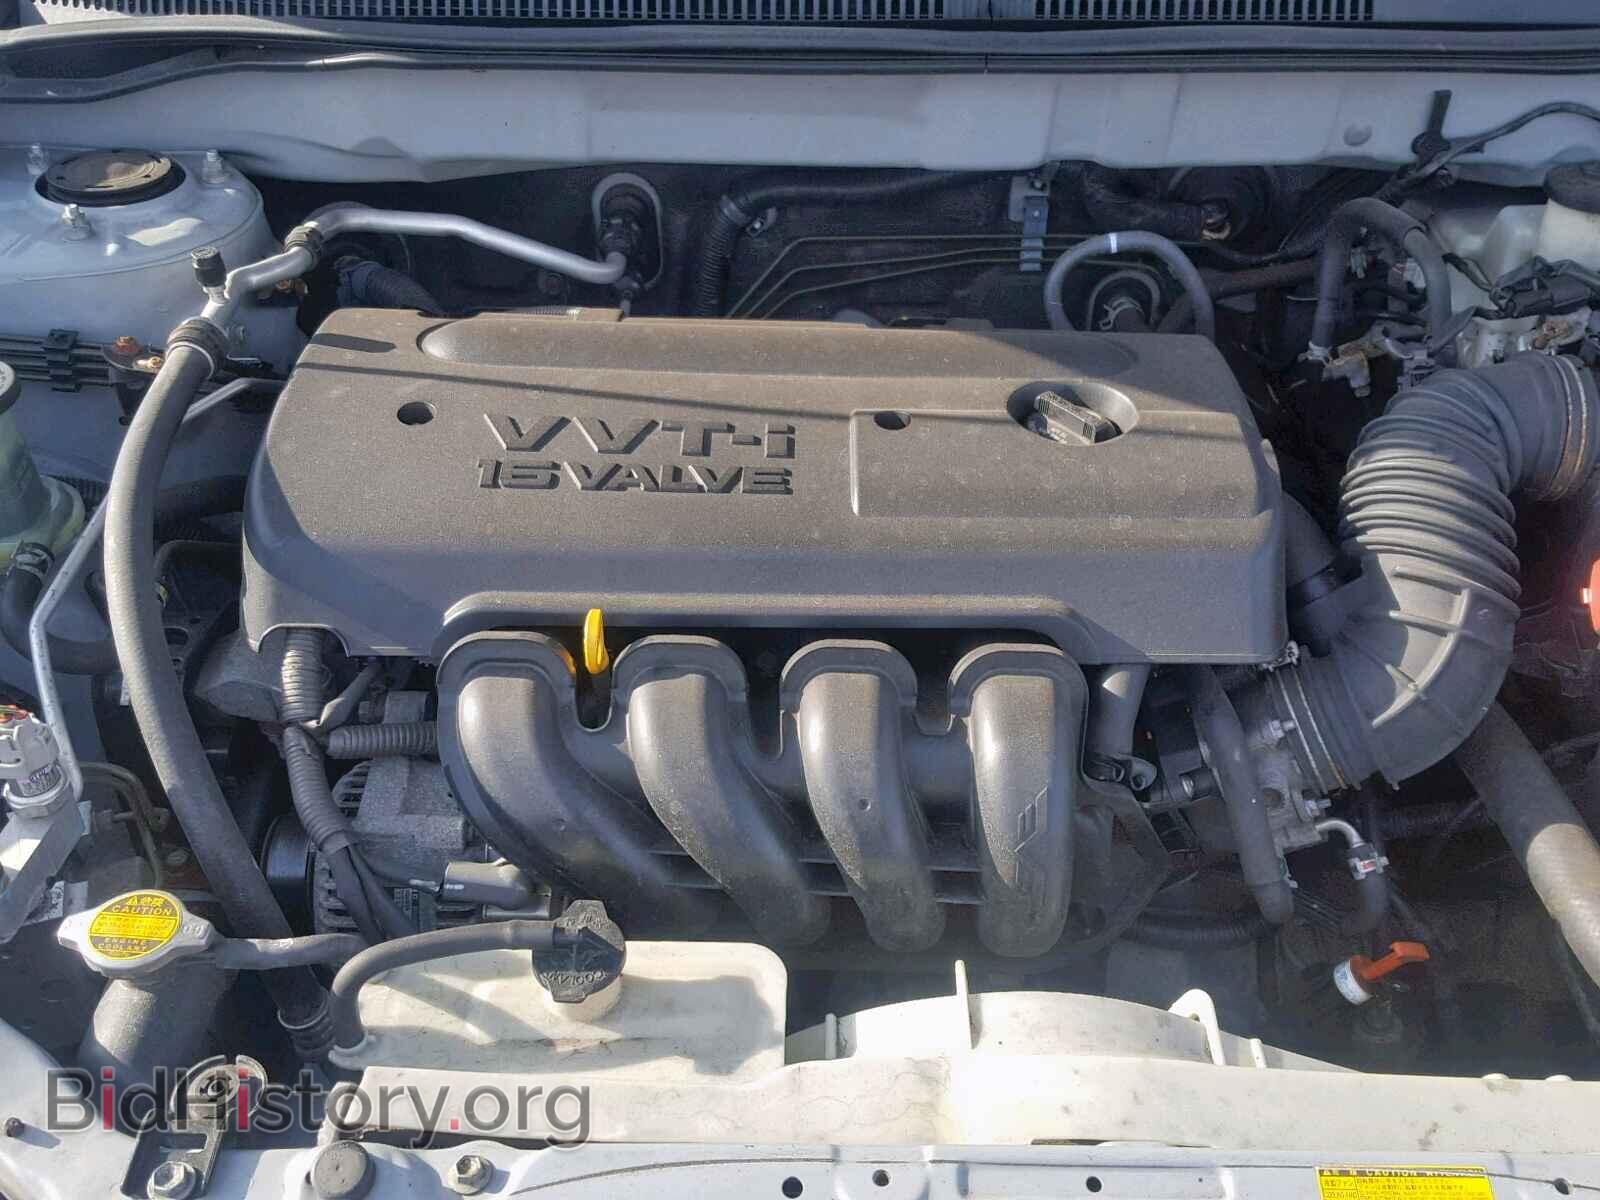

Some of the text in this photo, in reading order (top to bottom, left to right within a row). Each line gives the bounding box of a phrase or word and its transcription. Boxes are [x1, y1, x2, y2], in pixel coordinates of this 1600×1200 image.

[484, 413, 796, 459] VVT-i
[478, 460, 794, 495] 16 VALVE
[112, 904, 172, 916] CAUTION
